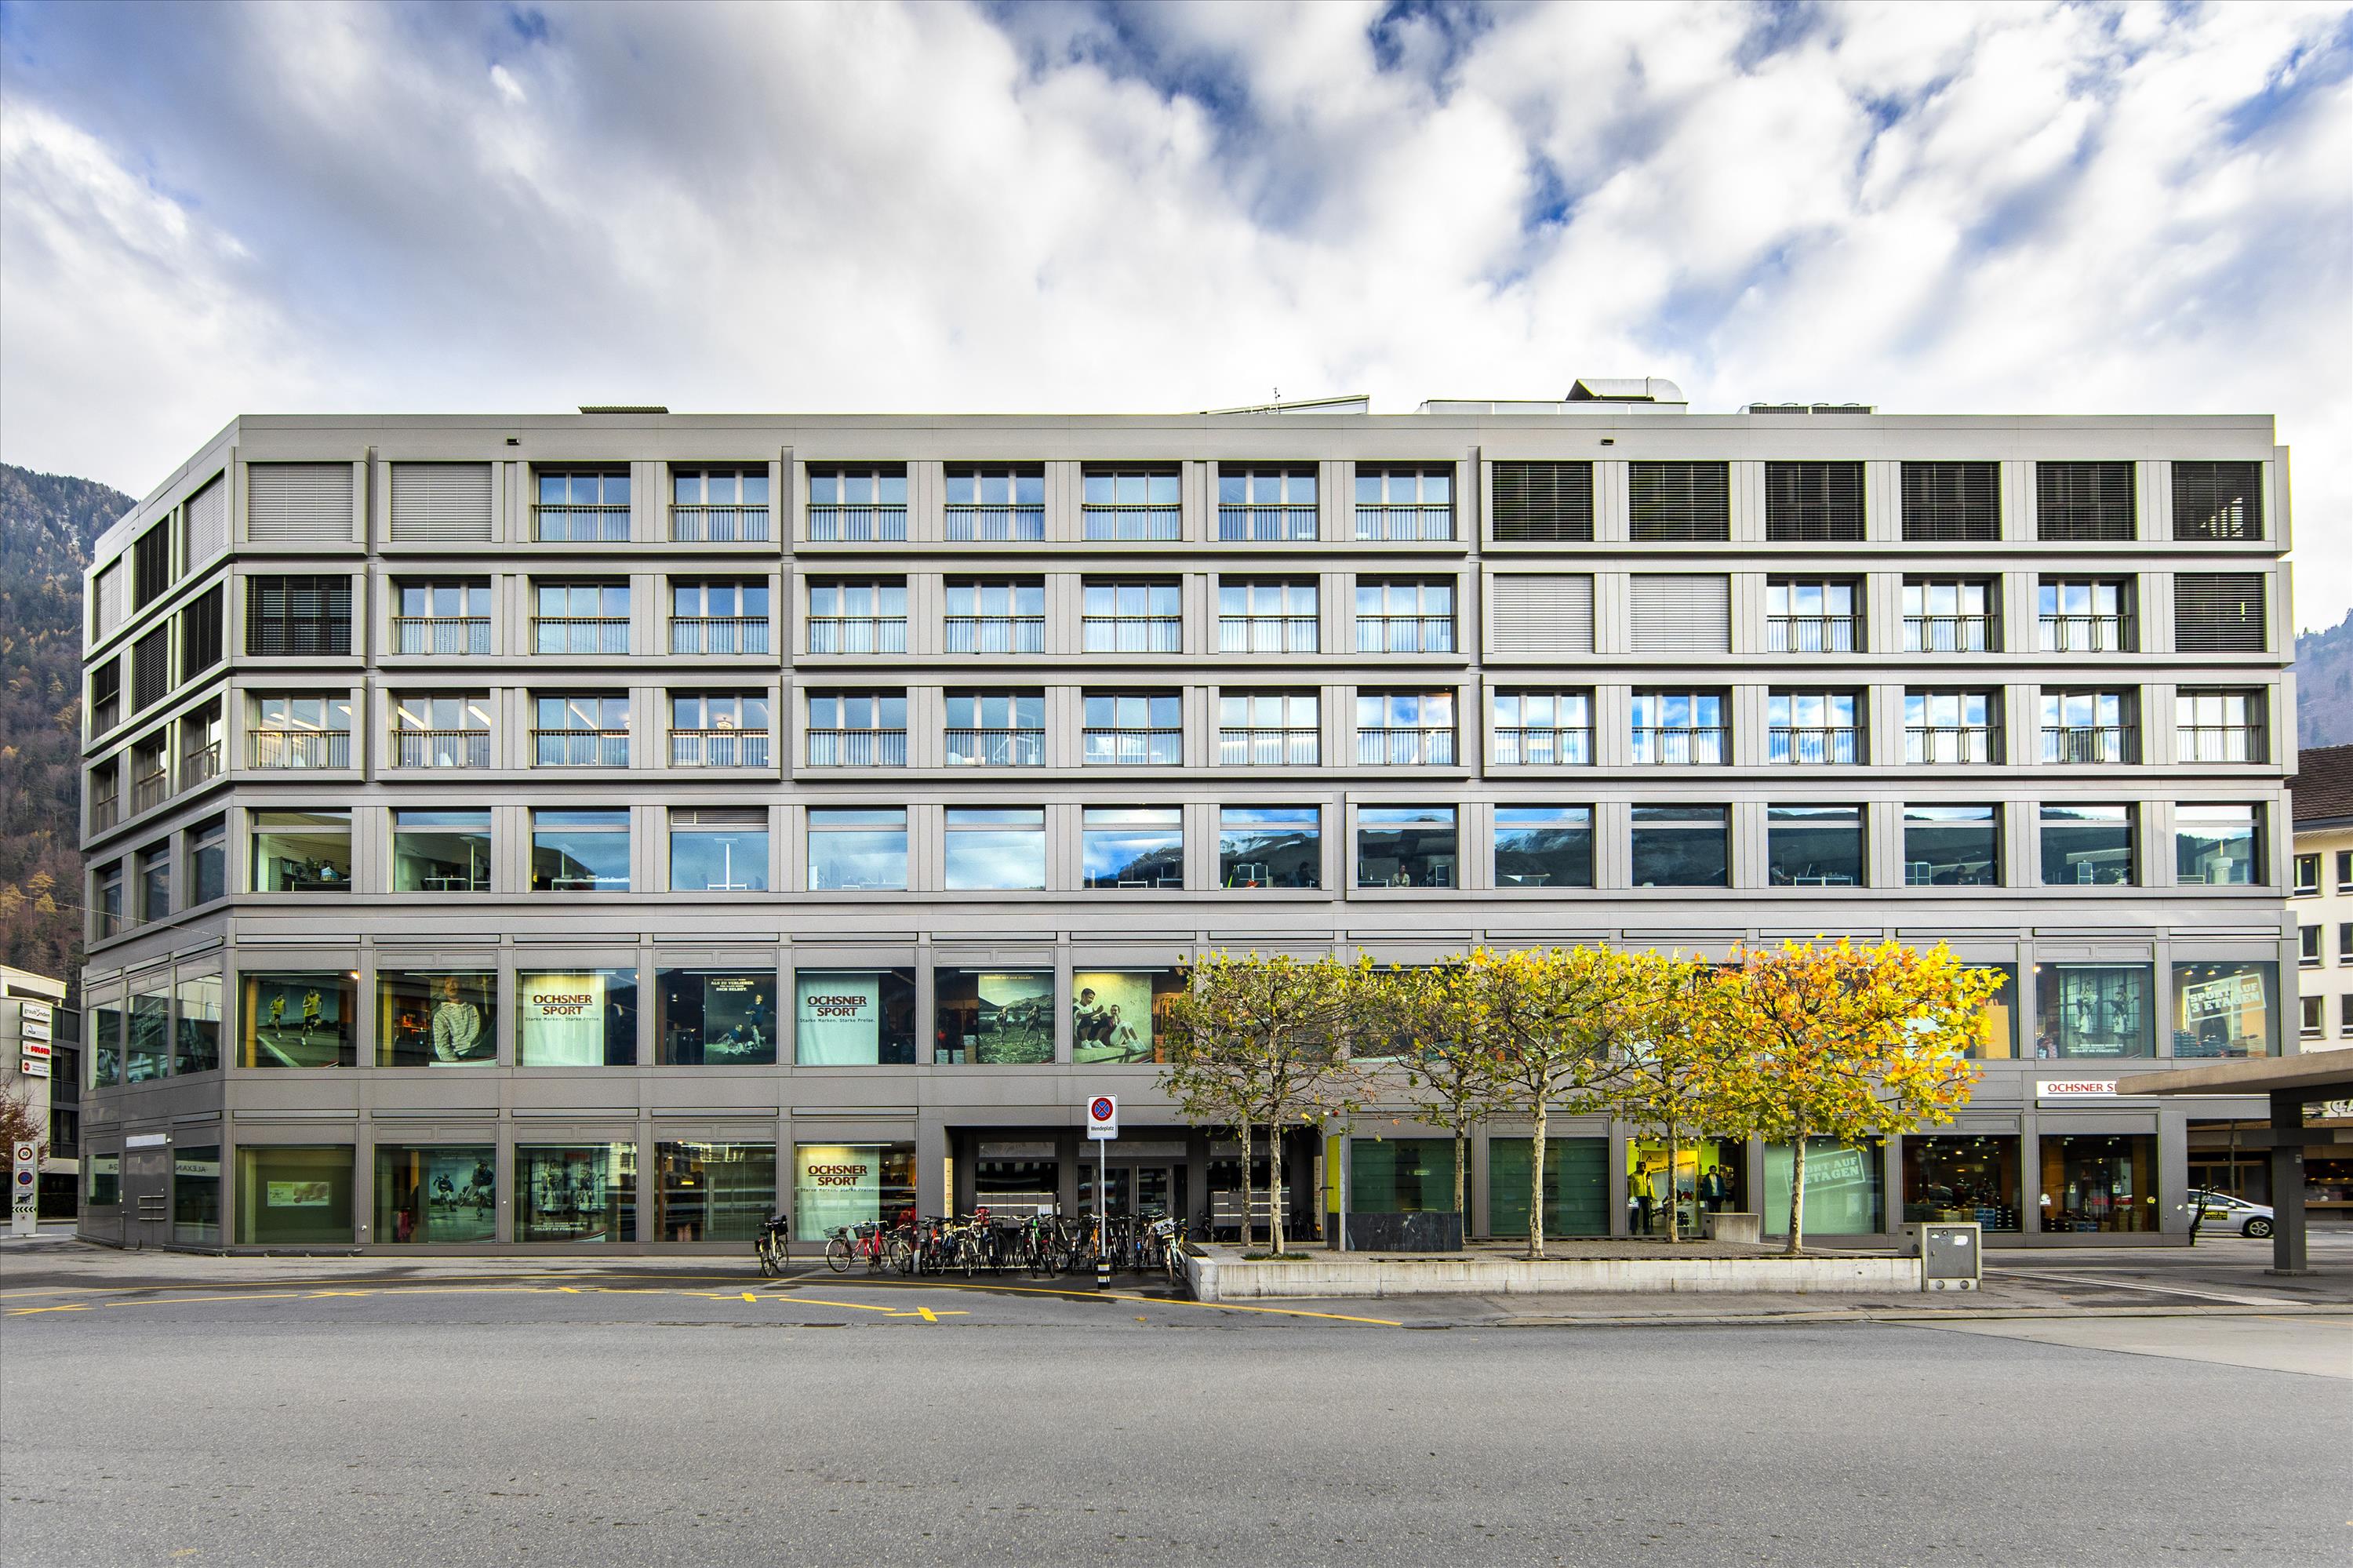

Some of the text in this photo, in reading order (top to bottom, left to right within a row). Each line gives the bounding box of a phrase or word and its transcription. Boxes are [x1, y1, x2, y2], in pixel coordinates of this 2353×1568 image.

[533, 995, 592, 1004] OCHSNER
[807, 995, 867, 1005] OCHSNER
[543, 1006, 584, 1015] SPORT
[816, 1007, 858, 1017] SPORT
[2048, 1083, 2117, 1092] OCHSNER S
[1835, 1156, 1857, 1169] AUF
[808, 1165, 867, 1174] OCHSNER
[1805, 1166, 1860, 1184] ETAGEN
[817, 1177, 859, 1186] SPORT
